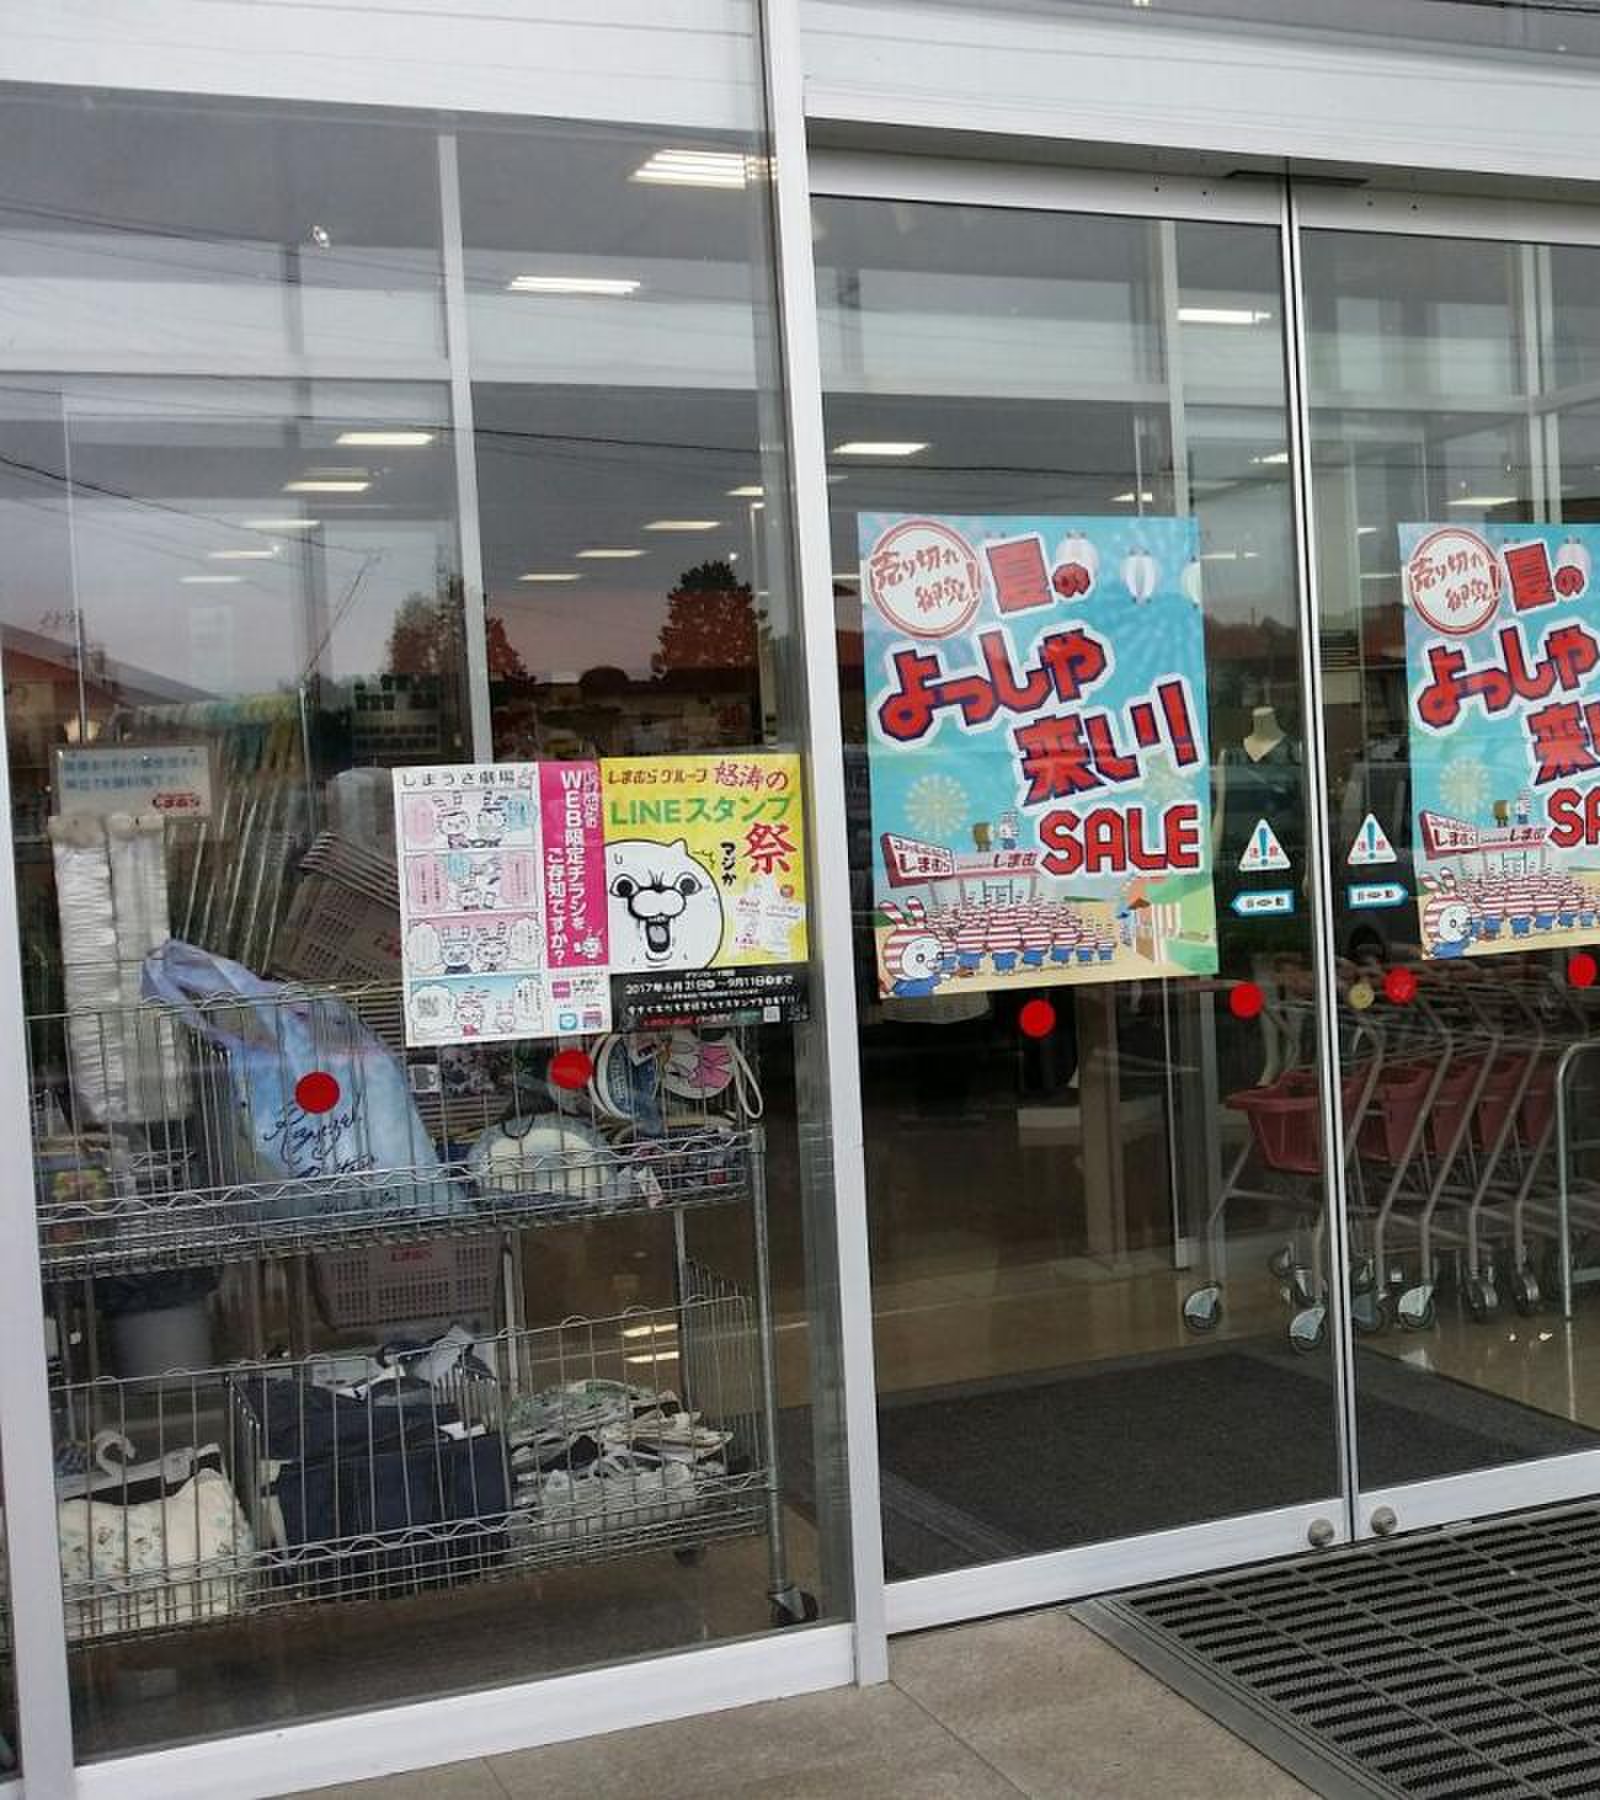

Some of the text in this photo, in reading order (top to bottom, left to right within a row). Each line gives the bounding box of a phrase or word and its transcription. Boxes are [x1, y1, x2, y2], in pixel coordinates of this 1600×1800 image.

[878, 628, 1107, 742] よっしゃ
[1417, 624, 1600, 729] よっしゃ
[714, 760, 789, 792] 怒涛の
[1014, 680, 1199, 806] 来い!
[720, 842, 737, 886] マジか
[742, 822, 797, 875] 祭
[1040, 805, 1199, 875] SALE
